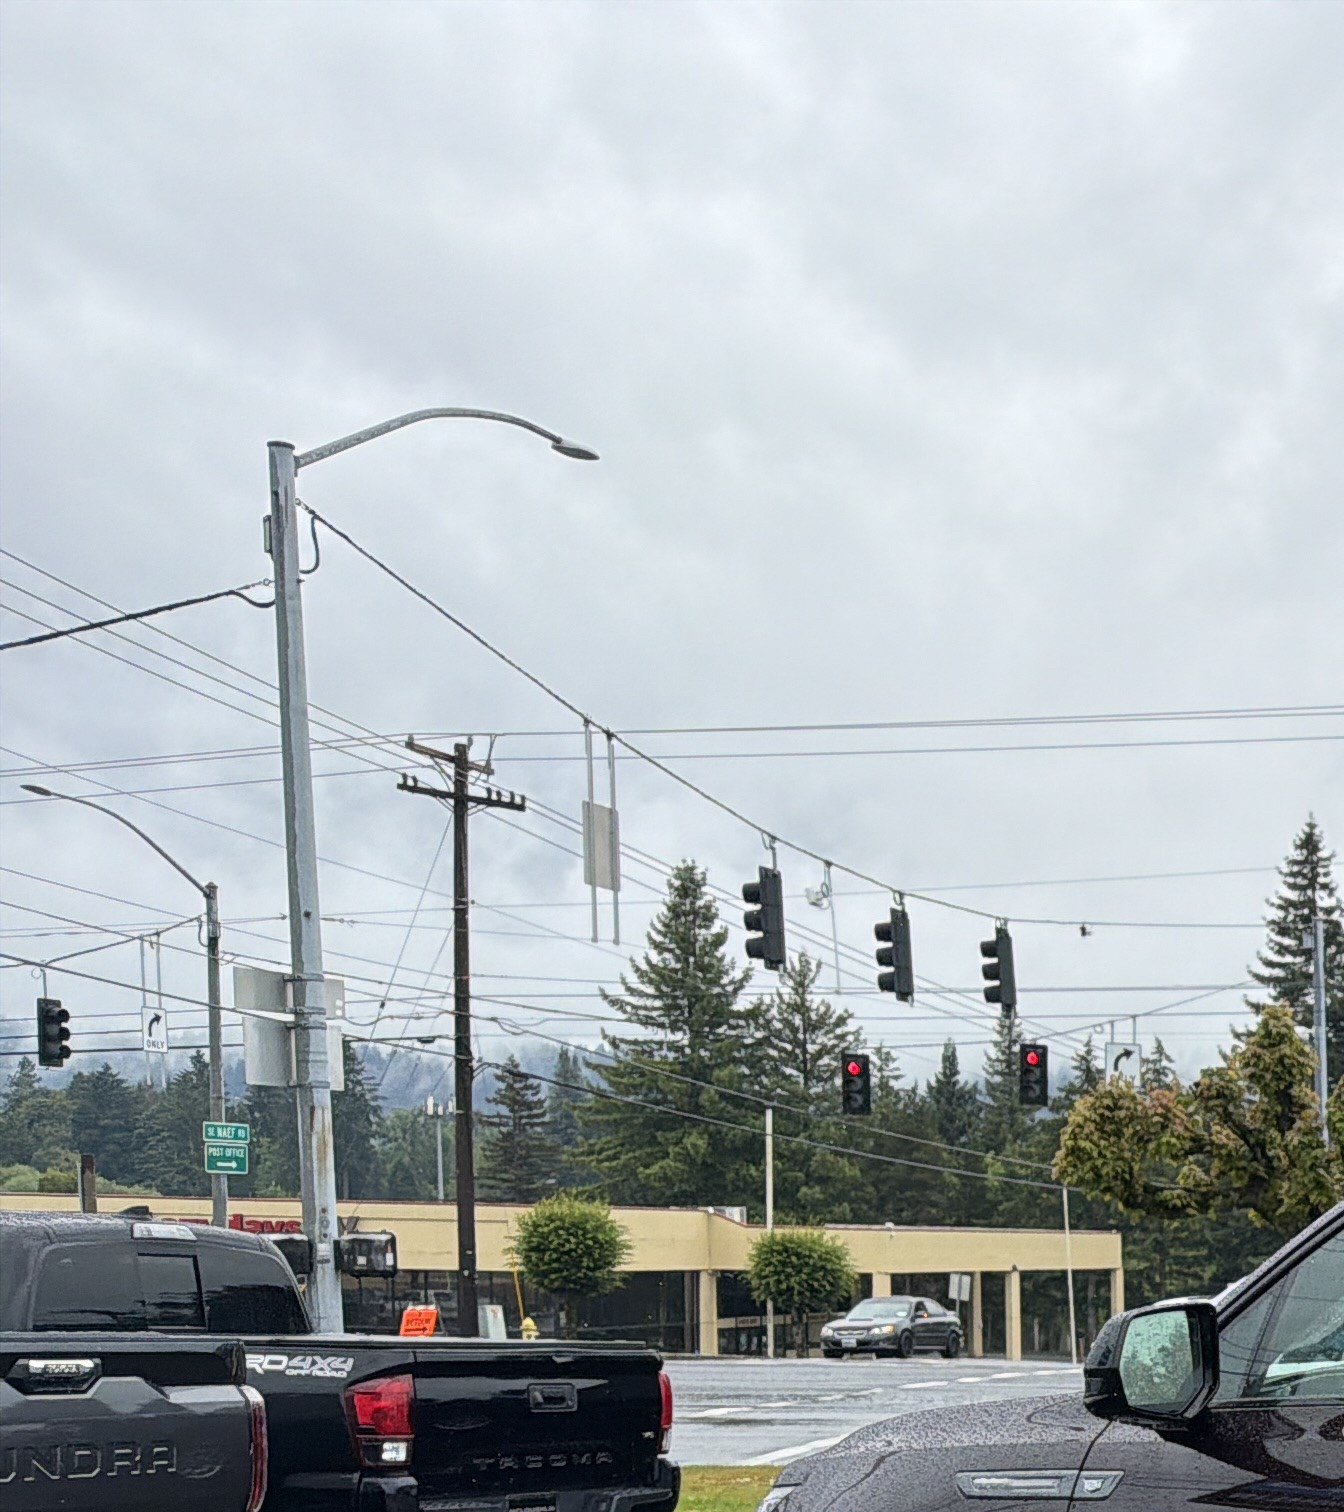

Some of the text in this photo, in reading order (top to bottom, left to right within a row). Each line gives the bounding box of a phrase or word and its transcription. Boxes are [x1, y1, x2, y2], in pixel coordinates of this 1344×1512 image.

[146, 1039, 165, 1049] ONLY
[208, 1146, 245, 1158] POST OFFICE
[285, 1368, 348, 1379] OFF ROAD
[472, 1450, 613, 1472] TACOMA
